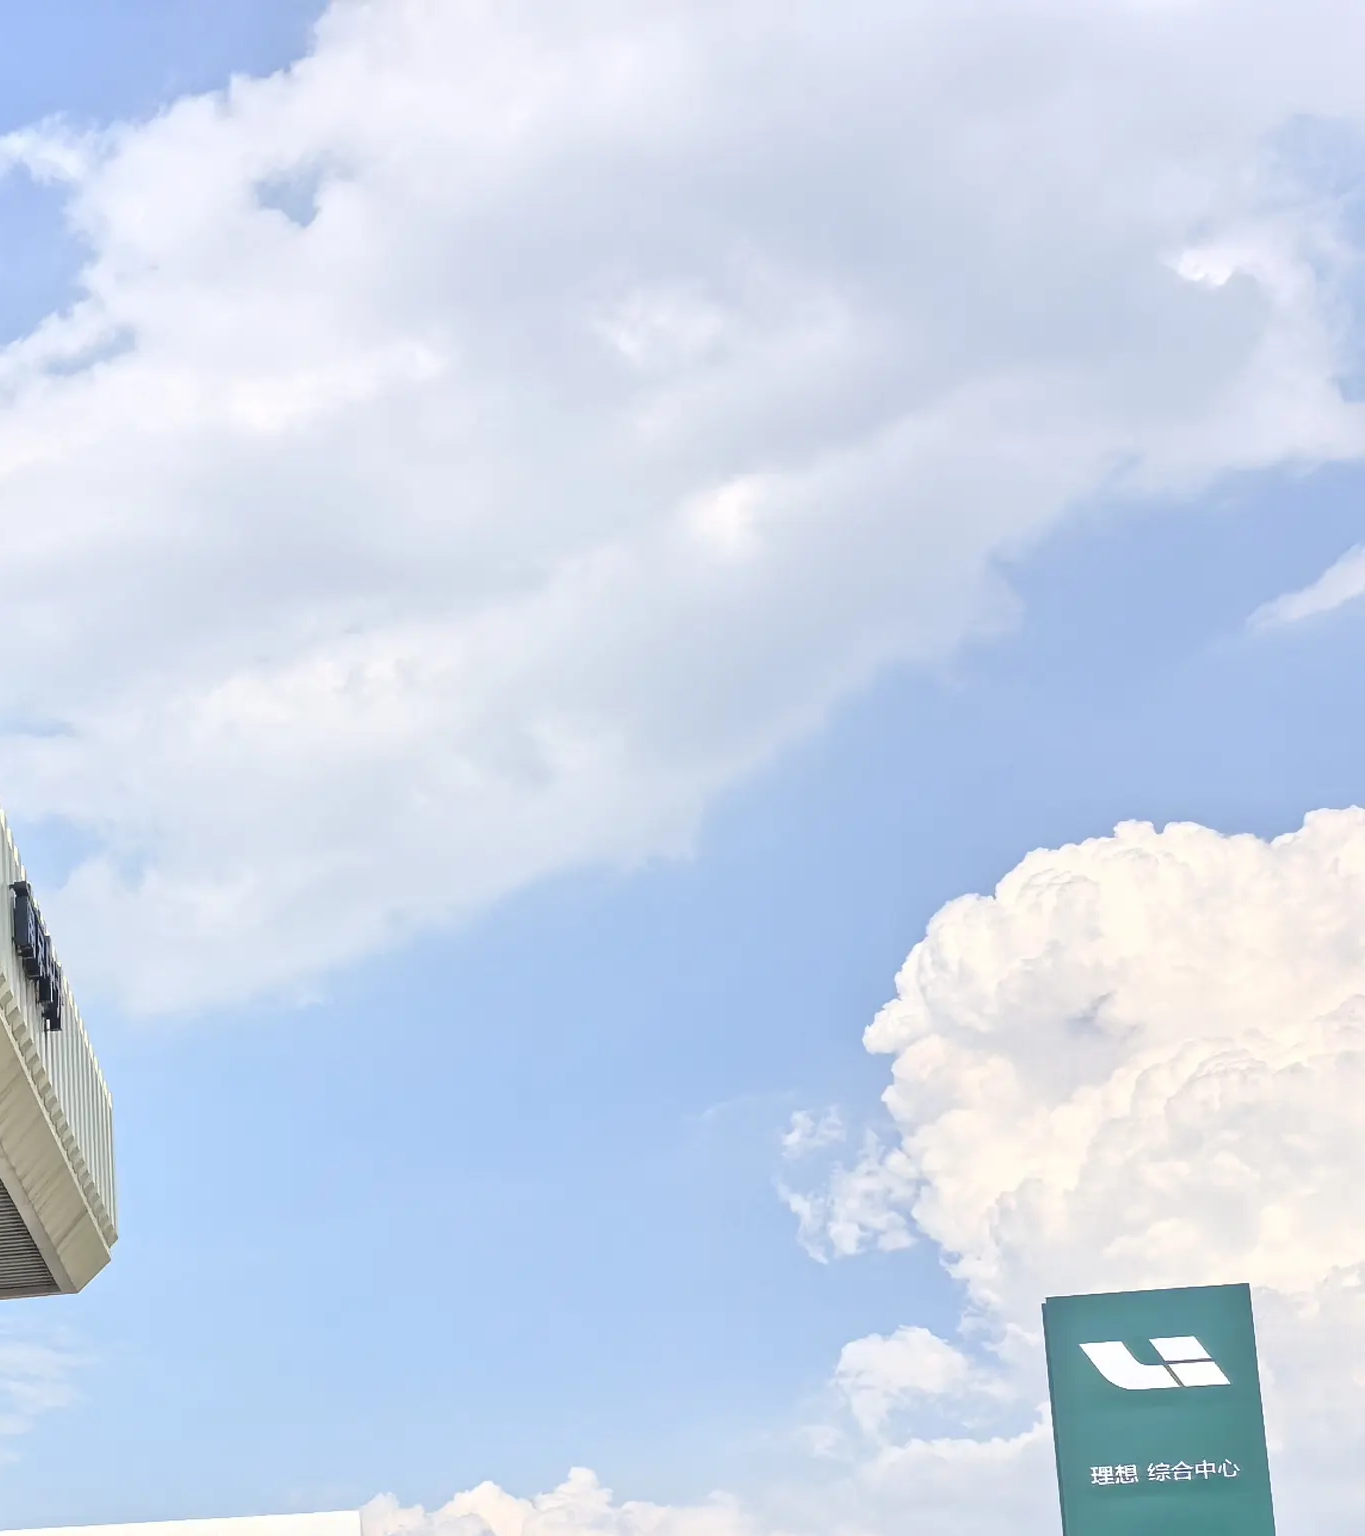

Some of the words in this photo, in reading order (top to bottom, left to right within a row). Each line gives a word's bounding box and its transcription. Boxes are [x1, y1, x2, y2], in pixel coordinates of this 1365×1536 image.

[1089, 1464, 1139, 1486] 理想
[1147, 1458, 1241, 1482] 综合中心
